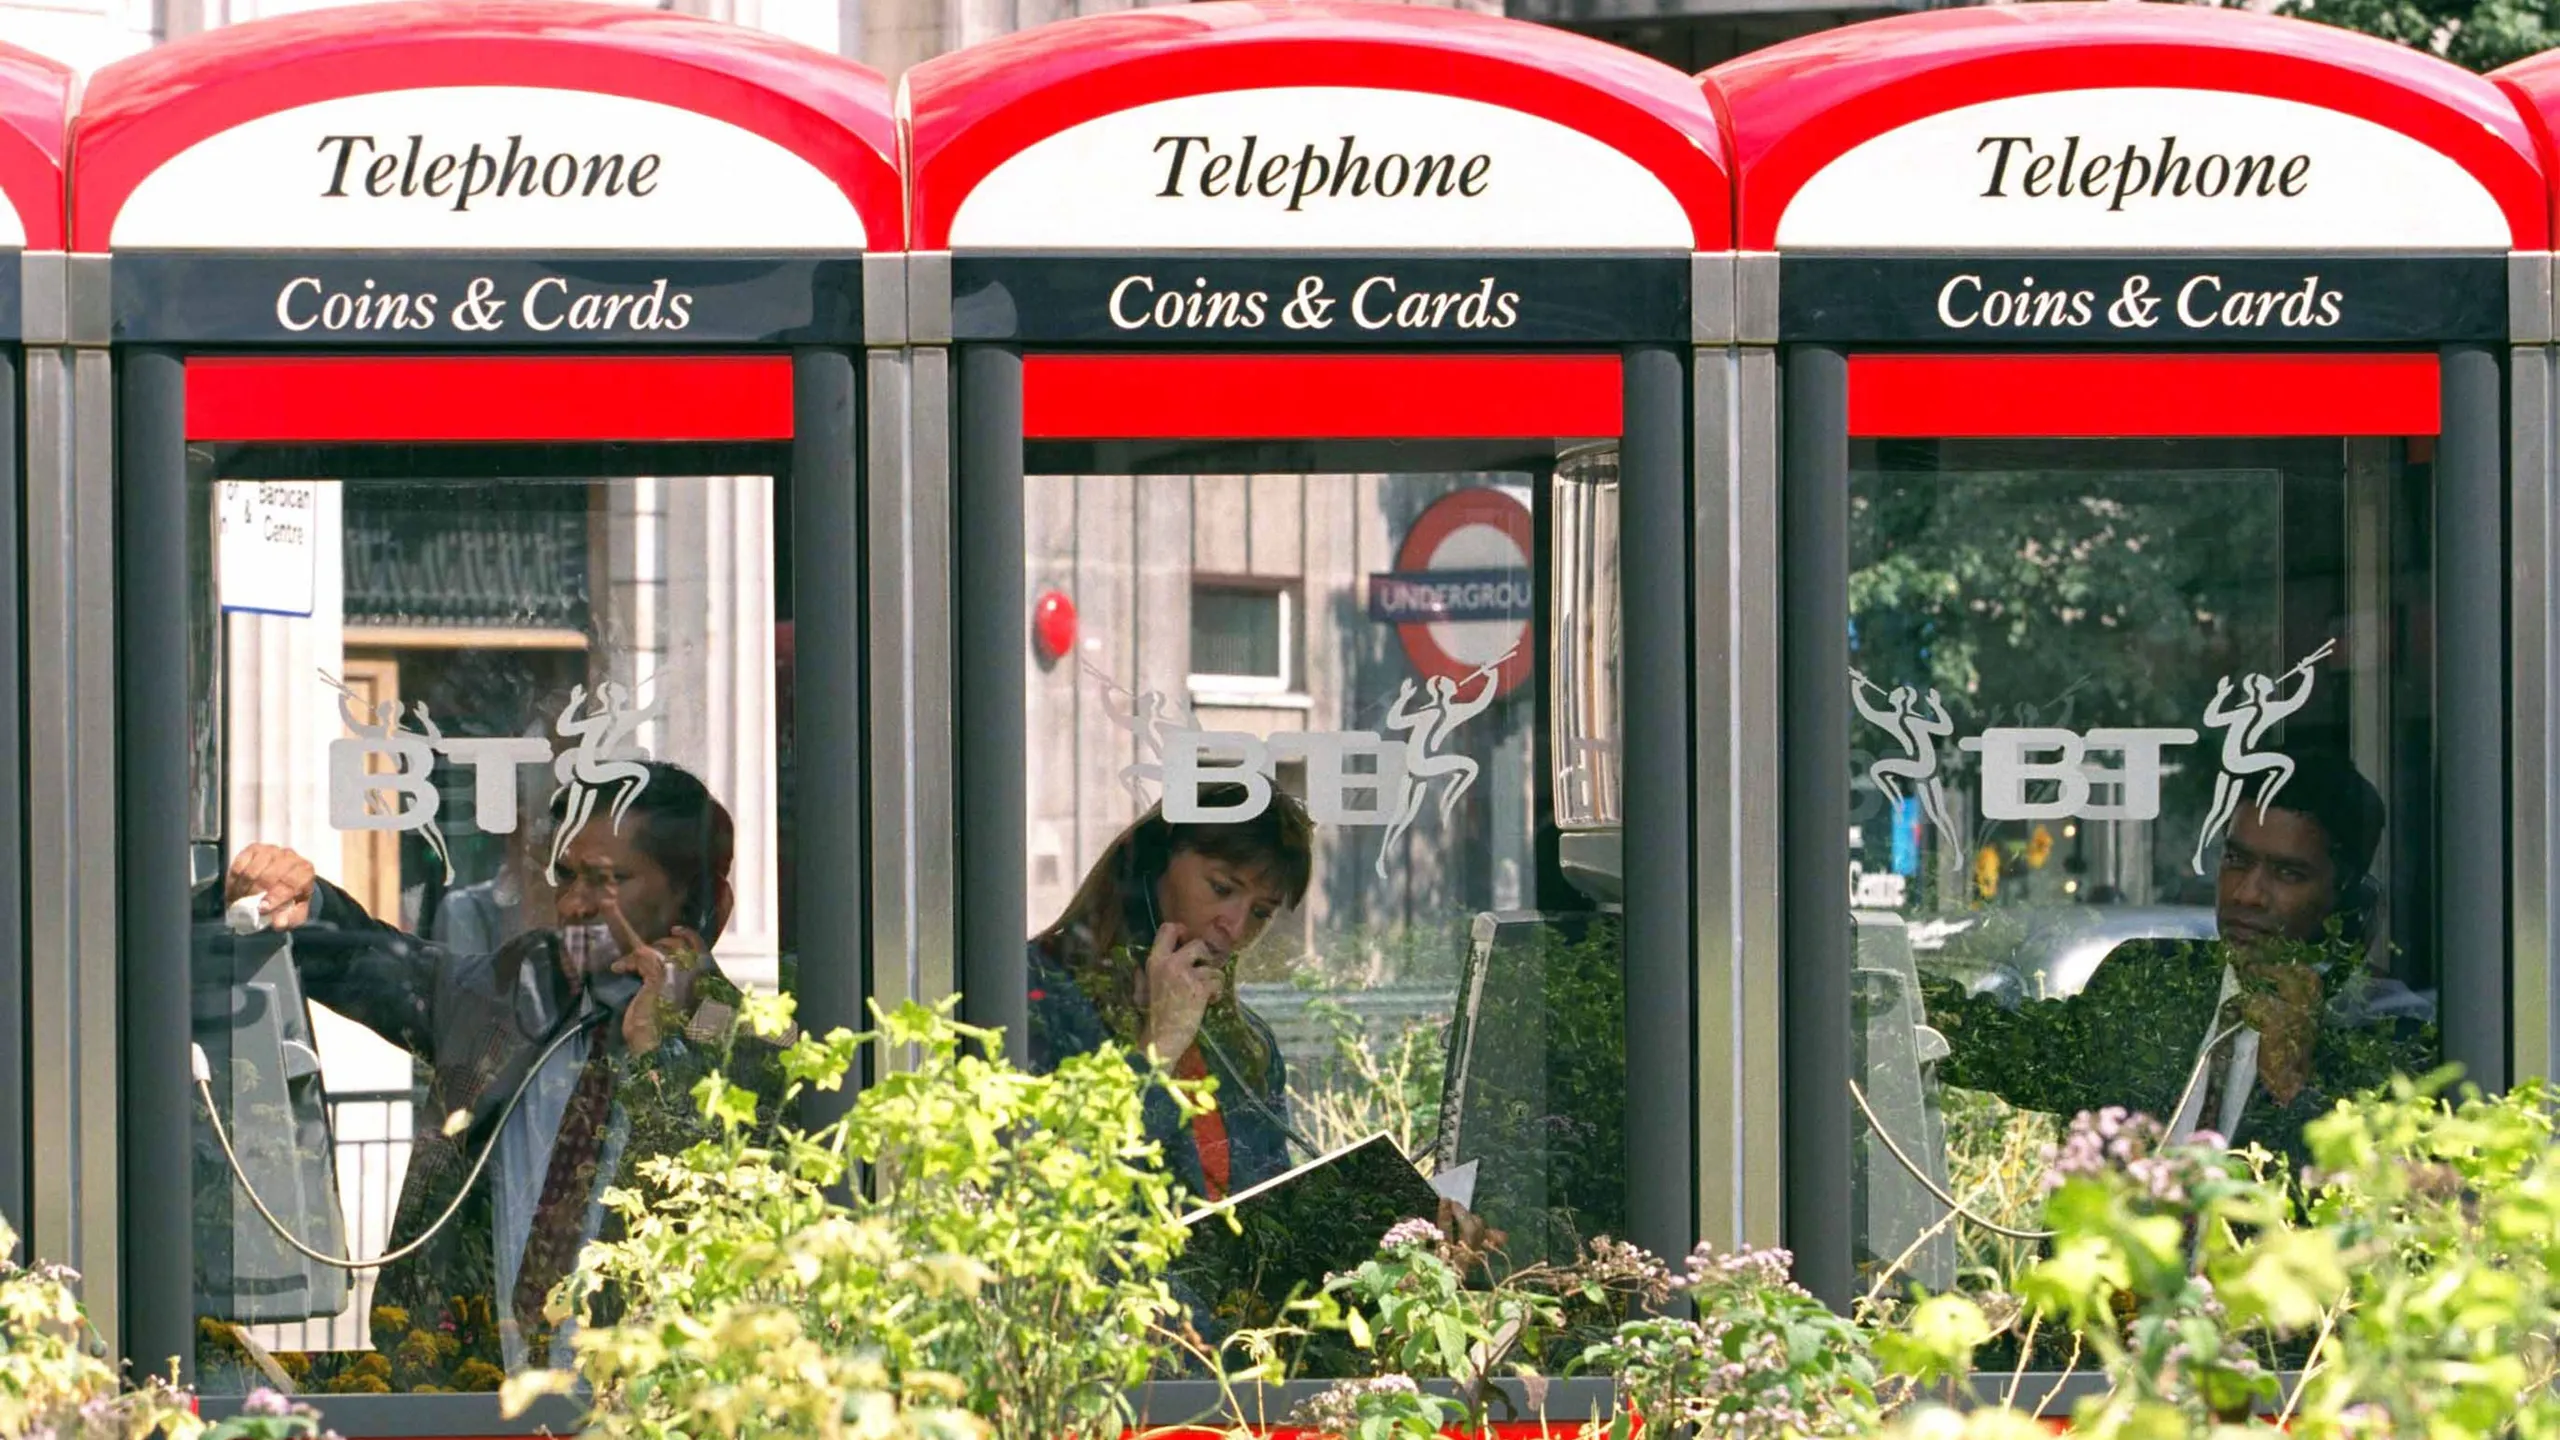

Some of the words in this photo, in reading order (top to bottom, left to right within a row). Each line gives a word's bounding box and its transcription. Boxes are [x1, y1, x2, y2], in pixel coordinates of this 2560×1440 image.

[319, 136, 659, 211] Telephone
[1155, 136, 1489, 211] Telephone
[1978, 136, 2309, 211] Telephone
[276, 277, 437, 331] Coins
[452, 277, 506, 331] &
[523, 278, 692, 331] Cards
[1109, 276, 1267, 329] Coins
[1282, 276, 1335, 329] &
[1352, 277, 1519, 329] Cards
[1937, 275, 2094, 328] Coins
[2108, 275, 2161, 328] &
[2177, 276, 2342, 328] Cards
[259, 481, 311, 510] Barbican
[264, 514, 304, 545] Centre
[1380, 583, 1532, 612] UNDERGROU
[329, 737, 554, 833] BT
